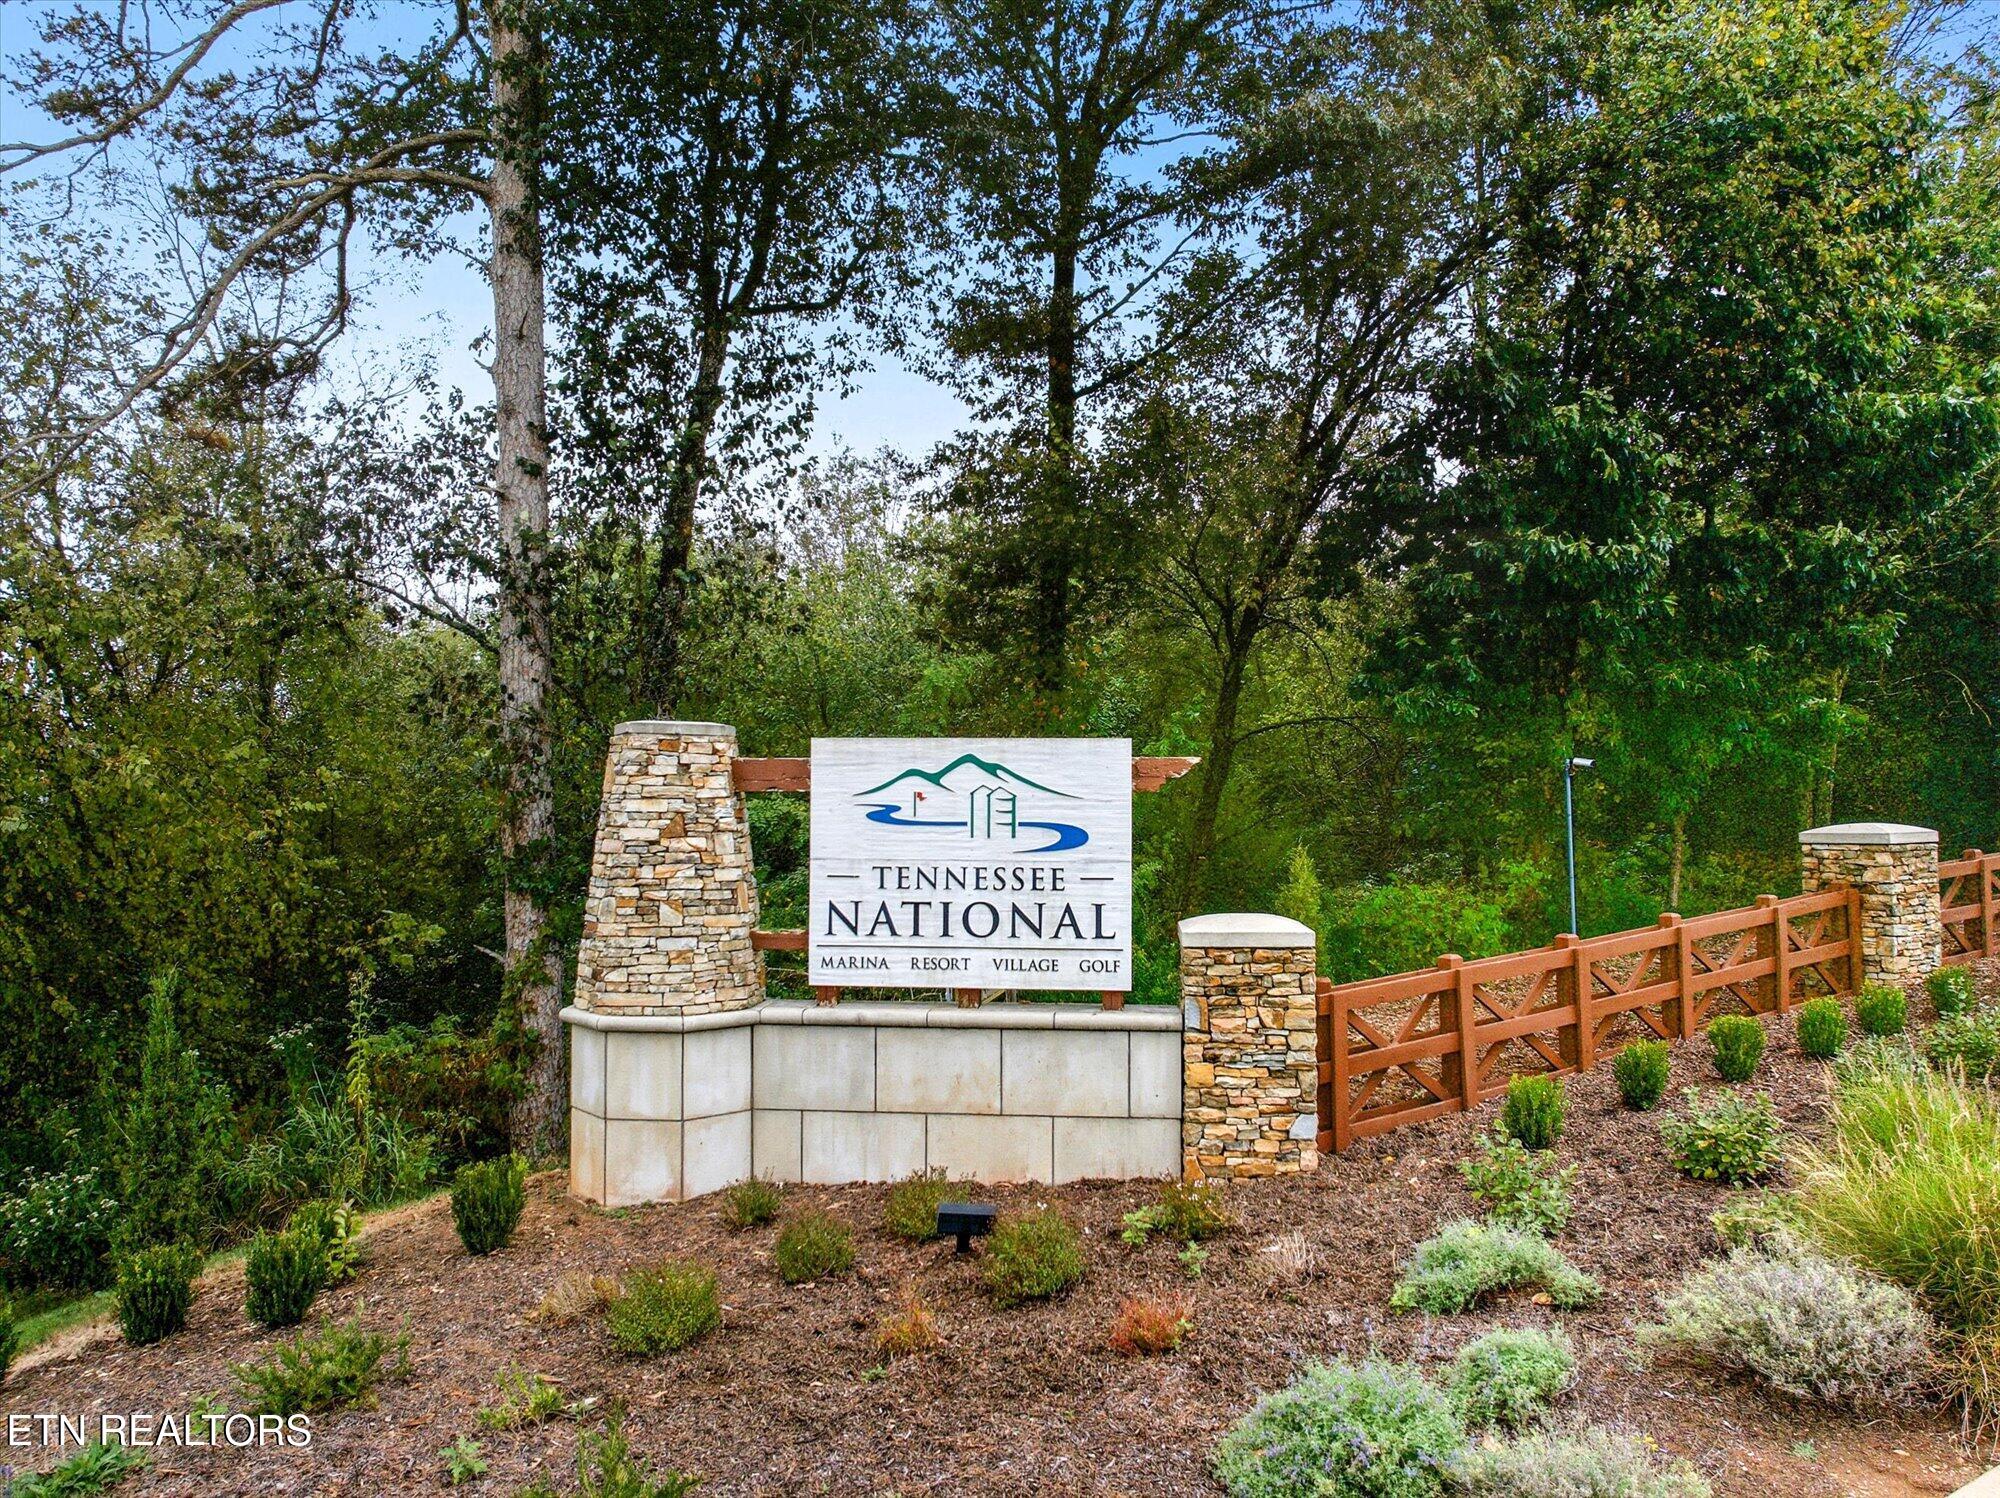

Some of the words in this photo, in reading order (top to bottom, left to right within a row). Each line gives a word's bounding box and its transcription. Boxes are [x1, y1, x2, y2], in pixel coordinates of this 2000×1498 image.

[872, 866, 1066, 892] TENNESSEE
[824, 900, 1116, 940] NATIONAL
[820, 956, 889, 970] MARINA
[911, 957, 971, 971] RESORT
[992, 958, 1059, 972] VILLAGE
[1079, 959, 1120, 973] GOLF
